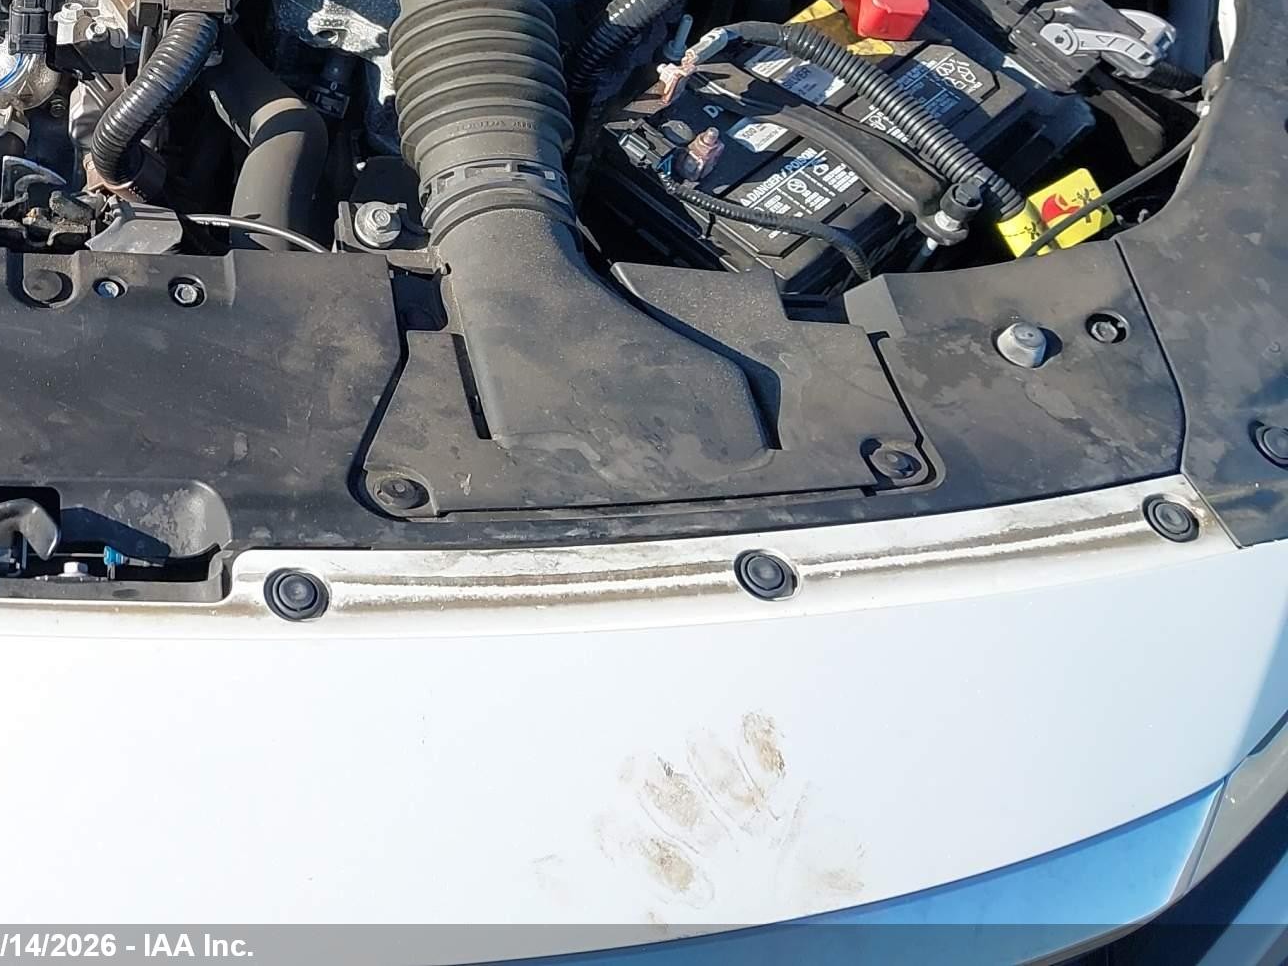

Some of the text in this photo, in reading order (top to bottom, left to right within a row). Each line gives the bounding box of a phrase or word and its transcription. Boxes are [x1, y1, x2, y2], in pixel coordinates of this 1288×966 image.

[783, 66, 812, 90] SILVER
[748, 173, 784, 204] DANGER
[785, 147, 819, 175] POISON
